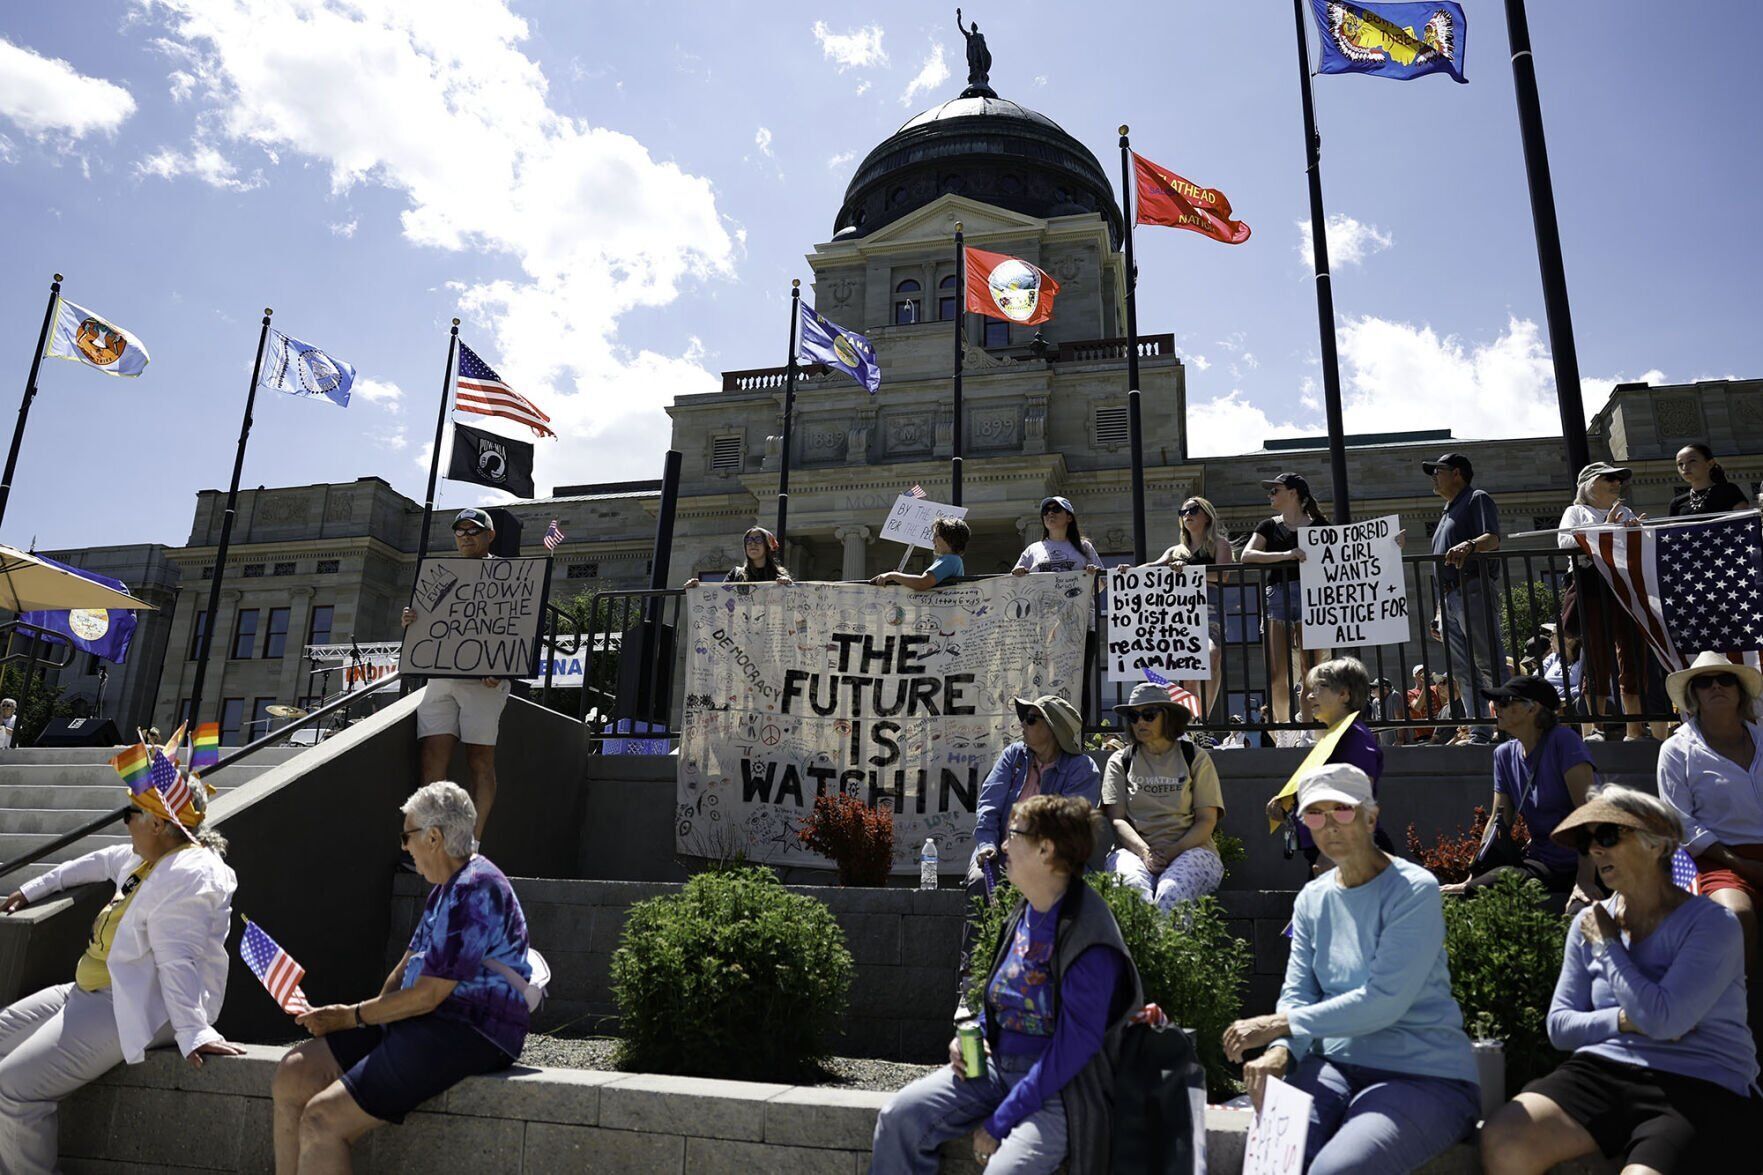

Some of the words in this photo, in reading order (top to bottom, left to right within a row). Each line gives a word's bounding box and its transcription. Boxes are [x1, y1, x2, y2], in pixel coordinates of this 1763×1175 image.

[1158, 173, 1216, 204] ATHEAD
[809, 430, 845, 448] 1889
[975, 419, 1015, 439] 1899
[897, 503, 912, 516] BY
[914, 505, 931, 522] THE
[887, 519, 902, 532] FOR
[904, 522, 919, 537] THE
[920, 526, 934, 541] PEO
[1308, 528, 1338, 546] GOD
[1343, 520, 1389, 543] FORBID
[1321, 546, 1335, 564] A
[1341, 542, 1375, 562] GIRL
[1113, 573, 1139, 591] no
[1144, 569, 1187, 594] sign
[1192, 571, 1204, 588] is
[1323, 558, 1381, 583] WANTS
[427, 582, 449, 602] EVIL
[455, 580, 534, 601] CROWN
[1307, 581, 1379, 607] LIBERTY
[1387, 584, 1397, 593] +
[449, 601, 487, 618] FOR
[493, 599, 531, 616] THE
[1114, 593, 1142, 613] big
[1145, 590, 1206, 614] enough
[1305, 603, 1375, 626] JUSTICE
[1381, 597, 1409, 620] FOR
[430, 617, 520, 639] ORANGE
[1111, 613, 1131, 627] to
[1138, 608, 1168, 625] list
[1171, 611, 1200, 626] all
[1135, 625, 1156, 637] of
[1159, 624, 1190, 638] the
[1335, 624, 1366, 643] ALL
[410, 637, 534, 672] CLOWN
[831, 633, 930, 674] THE
[1109, 636, 1201, 654] reasons
[712, 628, 781, 703] DEMOCRACY
[1118, 656, 1125, 672] i
[1133, 655, 1164, 669] am
[1165, 653, 1206, 670] here.
[780, 669, 976, 718] FUTURE
[850, 720, 901, 767] IS
[740, 758, 985, 815] WATCHIN
[1143, 784, 1183, 793] COFFEE
